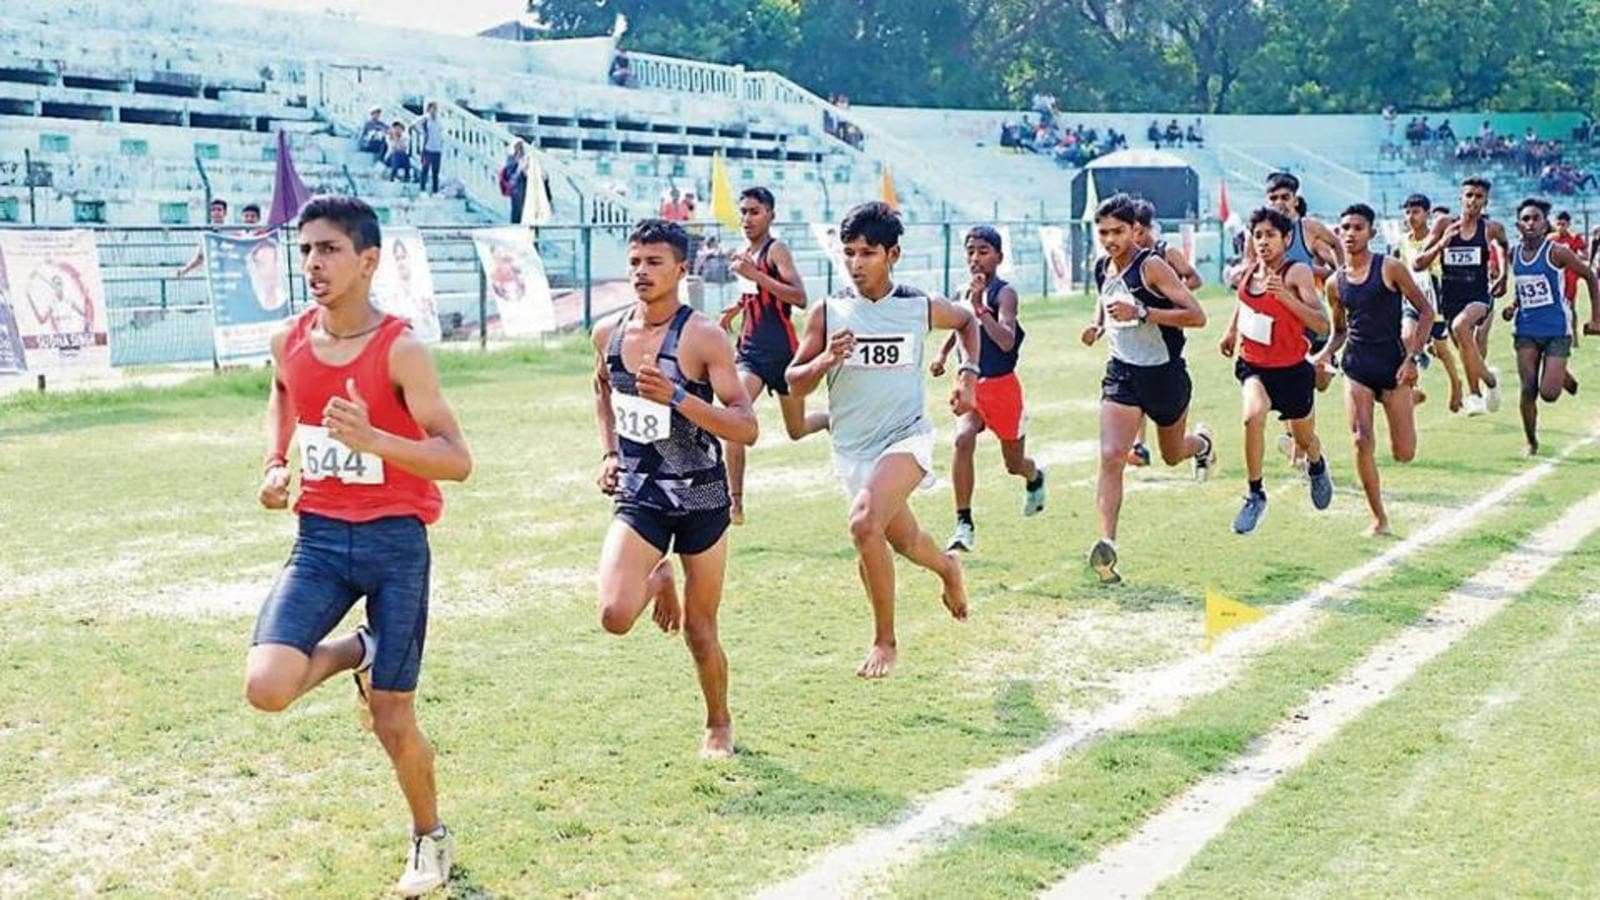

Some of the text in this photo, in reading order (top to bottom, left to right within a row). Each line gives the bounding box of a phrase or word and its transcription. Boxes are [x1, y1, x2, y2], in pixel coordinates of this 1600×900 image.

[1451, 253, 1473, 263] 125
[860, 344, 899, 365] 189
[306, 444, 367, 477] 644
